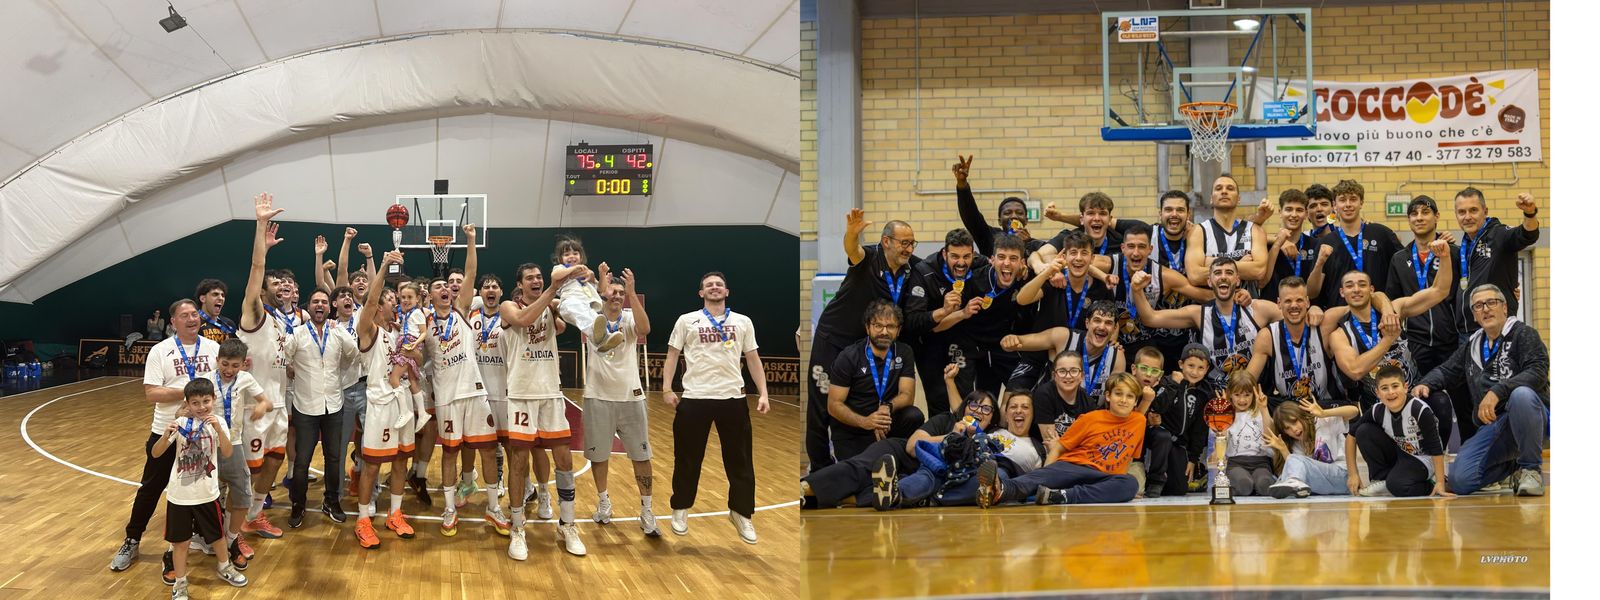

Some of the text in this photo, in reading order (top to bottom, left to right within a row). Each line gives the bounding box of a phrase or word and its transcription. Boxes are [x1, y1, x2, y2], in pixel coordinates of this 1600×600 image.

[1132, 17, 1157, 26] LNP
[1357, 129, 1379, 142] più
[1386, 128, 1433, 140] buono
[1439, 127, 1465, 138] che
[1471, 125, 1493, 136] c'è
[604, 154, 614, 168] 4
[1265, 153, 1287, 166] per
[1291, 151, 1322, 163] info:
[1326, 151, 1359, 163] 0771
[1364, 151, 1380, 162] 67
[1385, 151, 1401, 162] 47
[1405, 150, 1422, 161] 40
[1436, 148, 1460, 160] 377
[1465, 147, 1482, 159] 32
[1486, 147, 1503, 158] 79
[1507, 146, 1532, 158] 583
[596, 179, 631, 194] 0:00
[118, 353, 146, 364] ROM
[763, 362, 800, 371] ASKET
[766, 371, 800, 383] OMA
[514, 411, 529, 427] 12
[444, 420, 454, 433] 21
[382, 428, 391, 442] 5
[250, 438, 262, 453] 9
